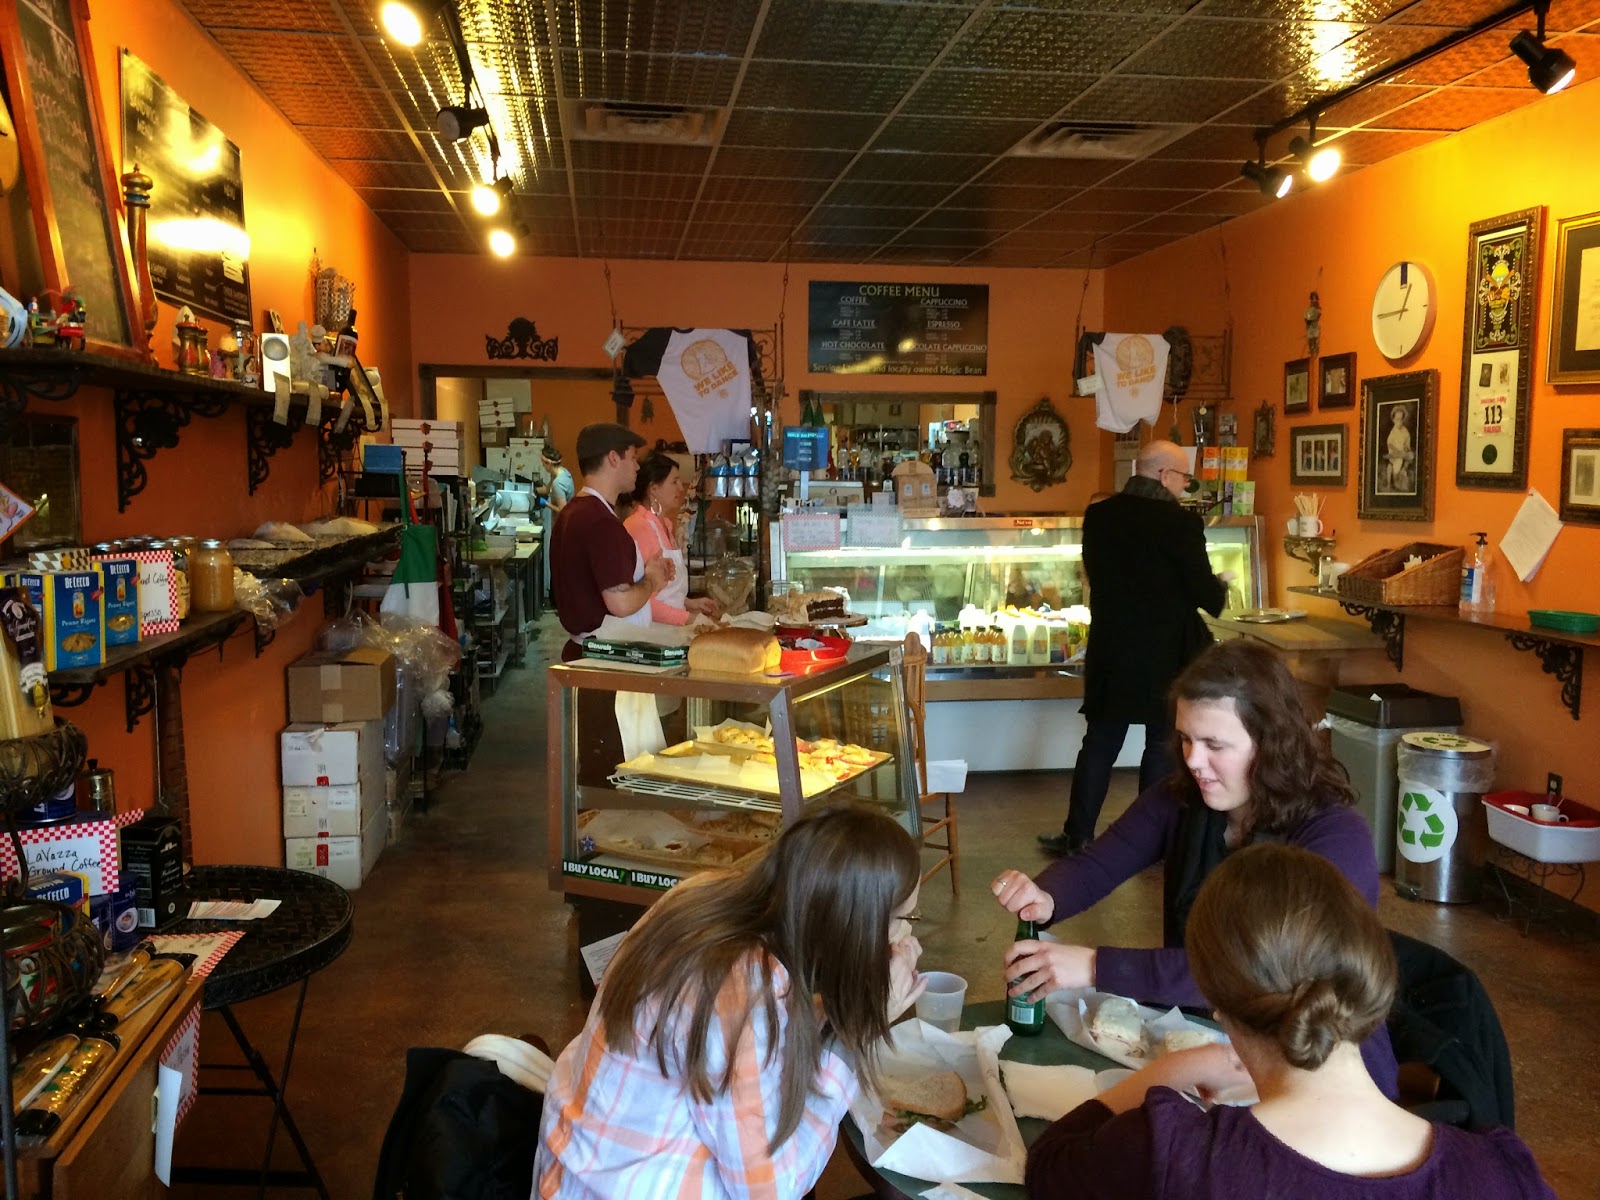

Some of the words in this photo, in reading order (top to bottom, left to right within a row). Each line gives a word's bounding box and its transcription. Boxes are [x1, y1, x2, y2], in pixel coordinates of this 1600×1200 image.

[859, 285, 901, 297] COFFEE
[904, 286, 940, 297] MENU
[920, 298, 968, 306] CAPPUCCINO
[927, 320, 960, 328] ESPRESSO
[822, 341, 838, 349] HOT
[839, 341, 885, 349] CHOCOLATE
[942, 343, 987, 351] CAPPUCCINO
[888, 364, 911, 375] locally
[913, 365, 938, 373] owned
[940, 366, 962, 375] Magic
[964, 366, 982, 374] Bean
[1484, 404, 1503, 425] 113
[73, 576, 90, 588] CECCO
[26, 847, 78, 865] LaVazza
[29, 862, 65, 877] Ground
[71, 857, 103, 872] Coffee
[563, 861, 567, 871] I
[568, 862, 588, 875] BUY
[632, 871, 636, 882] I
[636, 872, 657, 886] BUY
[658, 876, 682, 888] LOC
